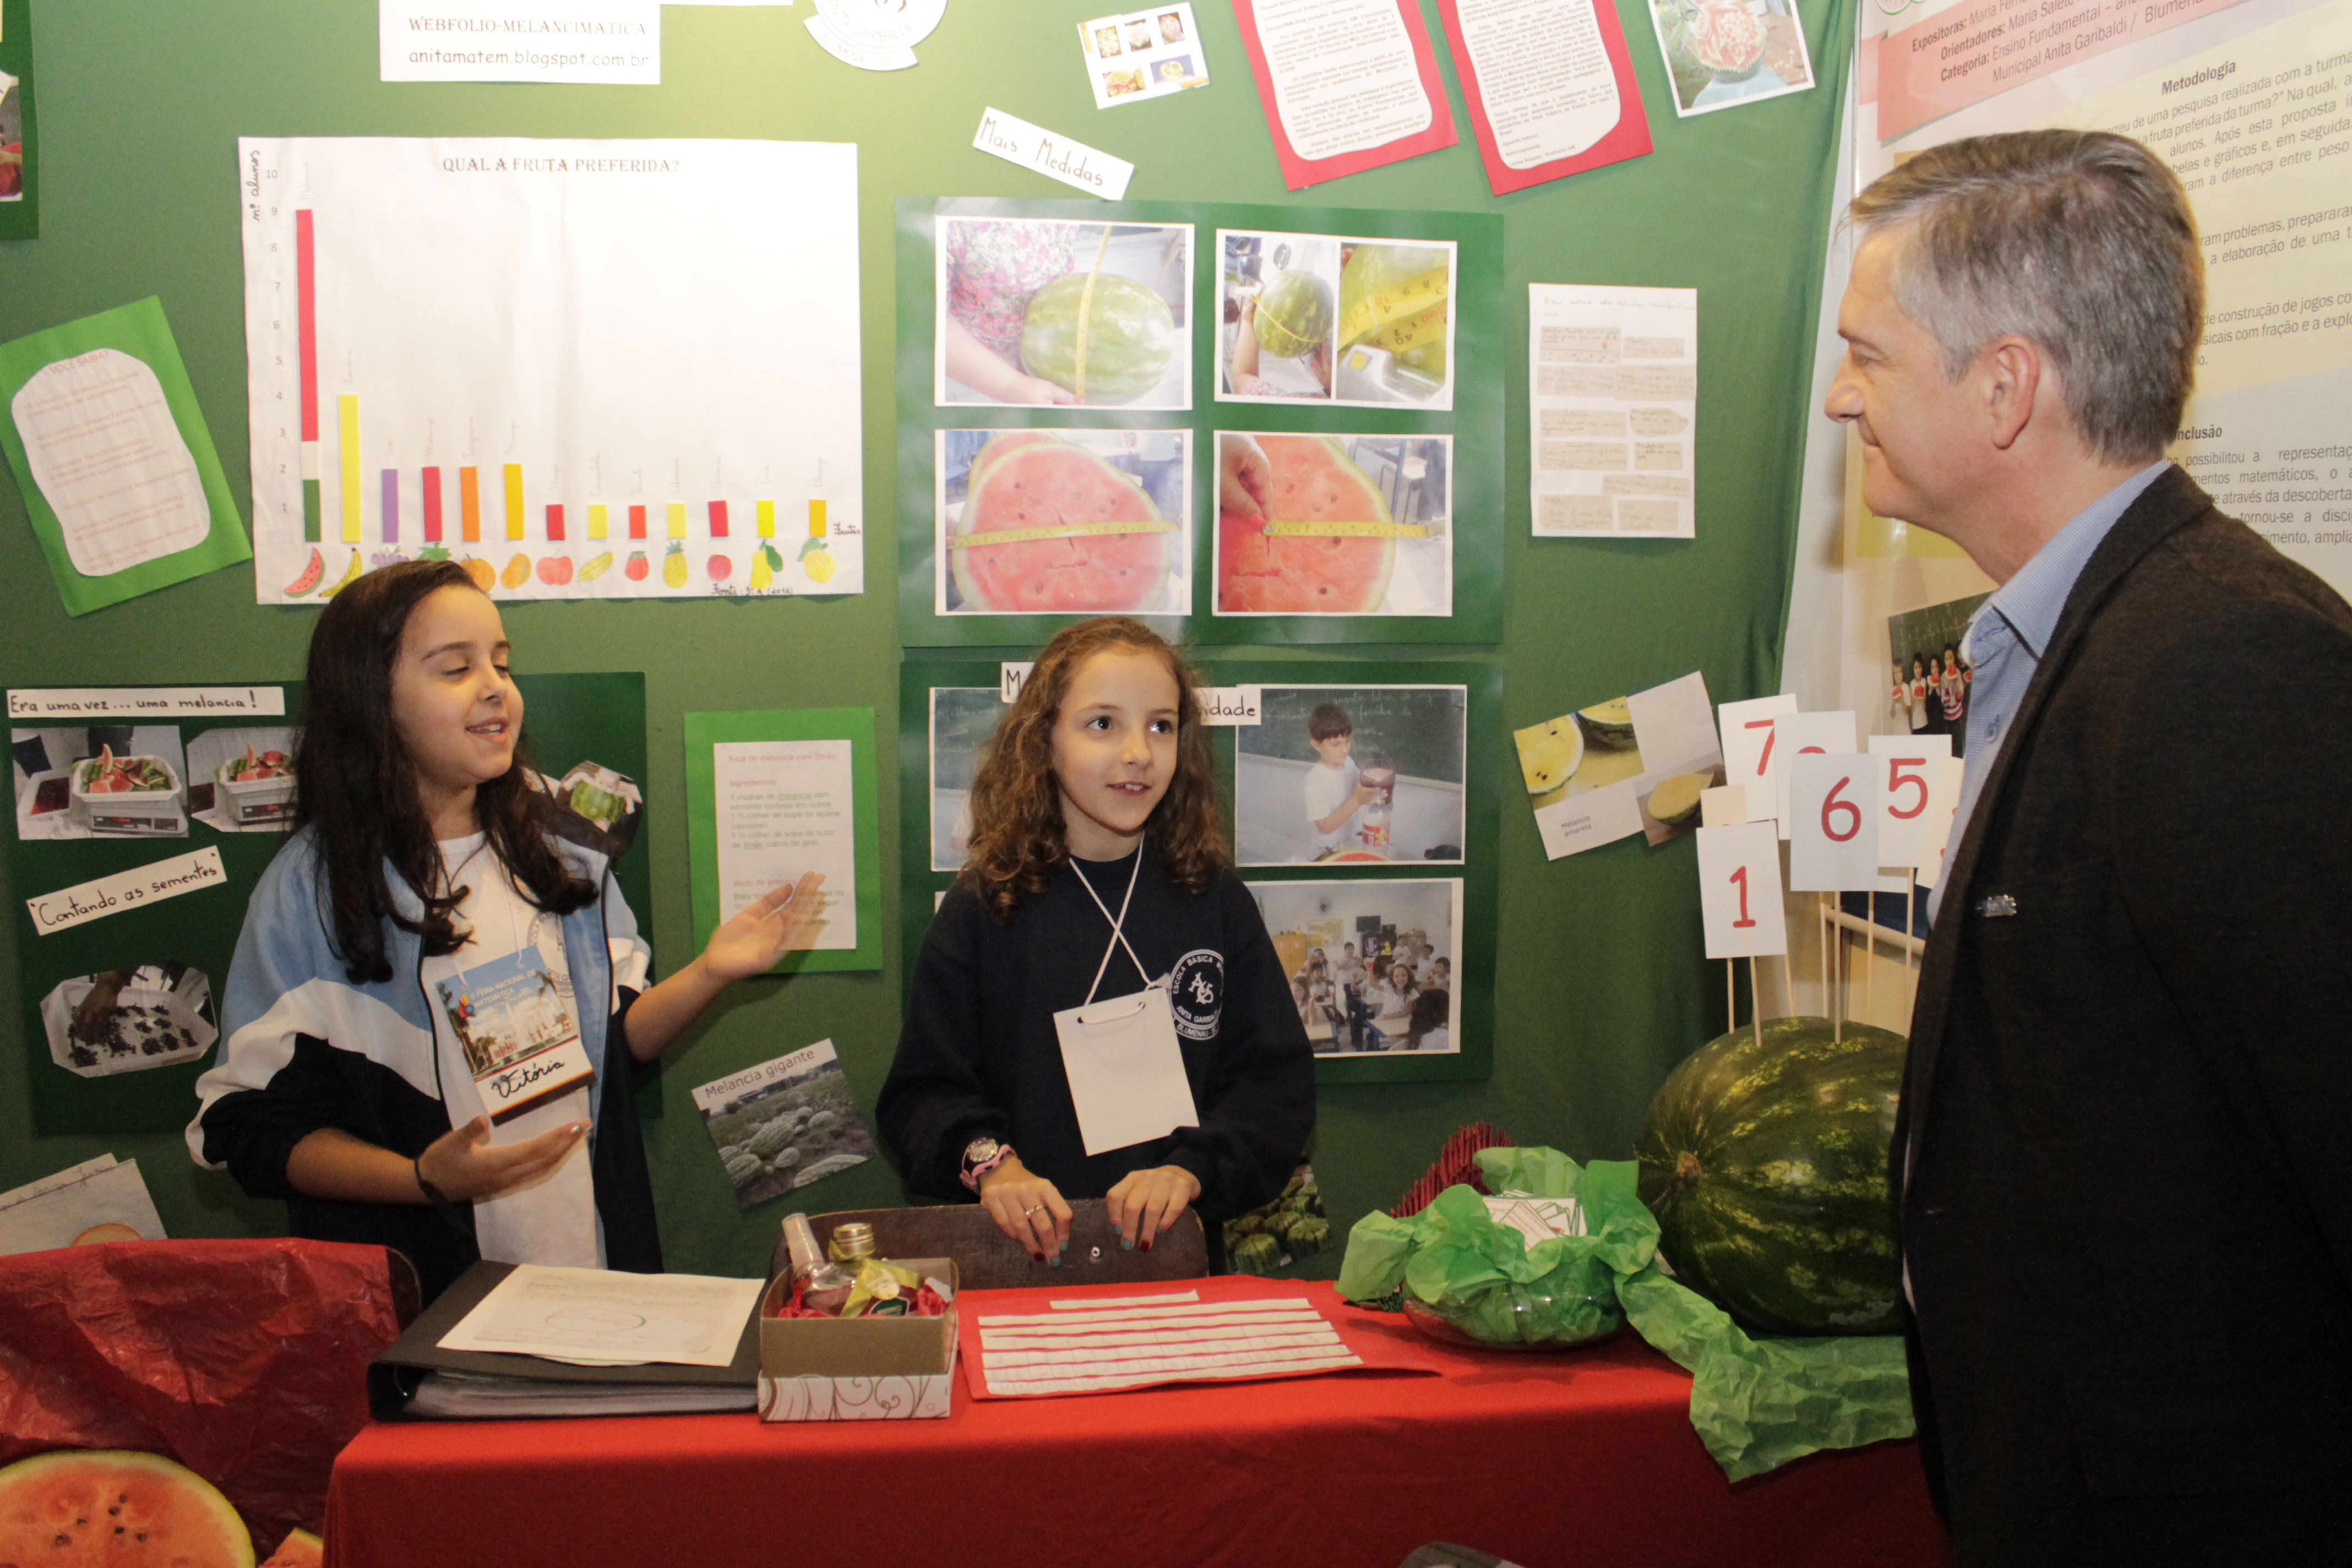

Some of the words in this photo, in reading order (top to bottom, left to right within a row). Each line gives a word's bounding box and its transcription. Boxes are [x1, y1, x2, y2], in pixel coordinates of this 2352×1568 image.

[1912, 18, 1967, 52] Expositoras:
[1969, 4, 1996, 26] Maria
[1941, 23, 2006, 61] Orientadores:
[2009, 9, 2037, 31] Maria
[1941, 53, 1990, 82] Categoria:
[1992, 37, 2026, 61] Ensino
[2029, 3, 2100, 46] Fundamental
[1993, 53, 2041, 84] Municipal
[2044, 41, 2072, 63] Anita
[2075, 16, 2127, 50] Garibaldi
[409, 49, 649, 69] anitamatem.blogspot.com.br
[2162, 61, 2236, 96] Metodologia
[2133, 117, 2144, 129] de
[2148, 110, 2169, 124] uma
[2173, 94, 2218, 119] pesquisa
[2222, 77, 2271, 102] realizada
[2275, 68, 2300, 85] com
[2305, 65, 2312, 76] a
[2150, 128, 2173, 143] fruta
[2175, 113, 2221, 136] preferida
[2223, 108, 2236, 121] da
[2287, 88, 2304, 102] Na
[2307, 77, 2337, 99] qual,
[2170, 138, 2207, 156] alunos.
[2214, 126, 2241, 145] Após
[2248, 118, 2272, 134] esta
[2282, 101, 2336, 128] proposta
[980, 116, 1018, 153] Mais
[1035, 138, 1103, 187] Medidas
[2204, 156, 2210, 167] e
[2214, 144, 2257, 167] gráficos
[2261, 140, 2272, 152] e,
[2277, 133, 2295, 147] em
[246, 150, 260, 197] alunos
[266, 170, 278, 179] 10
[443, 157, 490, 172] QUAL
[496, 158, 508, 172] A
[513, 157, 569, 172] FRUTA
[575, 159, 679, 173] PREFERIDA?
[2209, 175, 2216, 186] a
[2222, 160, 2273, 182] diferença
[2280, 150, 2312, 167] entre
[2318, 141, 2350, 161] peso
[271, 207, 277, 215] 9
[2224, 220, 2285, 244] problemas,
[270, 243, 277, 252] 8
[2210, 254, 2217, 265] a
[2223, 239, 2284, 263] elaboração
[2290, 235, 2306, 249] de
[2312, 230, 2339, 244] uma
[275, 282, 281, 291] 7
[2218, 302, 2279, 323] construção
[2283, 300, 2297, 313] de
[2299, 295, 2333, 314] jogos
[273, 320, 280, 330] 6
[2235, 327, 2258, 341] com
[2262, 320, 2299, 337] fração
[2302, 320, 2309, 331] e
[2312, 319, 2320, 330] a
[50, 357, 75, 375] VOCÊ
[77, 349, 110, 368] SABIA?
[276, 356, 282, 364] 5
[280, 428, 286, 437] 3
[2175, 424, 2222, 440] nclusão
[280, 465, 286, 473] 2
[2186, 452, 2245, 468] possibilitou
[2253, 451, 2260, 461] a
[2240, 467, 2318, 483] matemáticos,
[2330, 469, 2338, 479] o
[2222, 489, 2262, 504] através
[2265, 489, 2279, 503] da
[2240, 511, 2294, 524] tornou-se
[2304, 511, 2311, 522] a
[10, 695, 38, 712] Era
[47, 703, 80, 711] uma
[137, 699, 168, 709] uma
[1745, 719, 1774, 776] 7
[729, 779, 776, 788] Ingredientes
[1888, 758, 1928, 819] 5
[1821, 776, 1861, 842] 6
[1561, 816, 1591, 829] Melancia
[1564, 824, 1592, 837] amarela
[125, 888, 144, 901] as
[1729, 865, 1756, 928] 1
[1173, 966, 1186, 994] ESCOLA
[1177, 1005, 1191, 1020] ANITA
[1177, 1024, 1208, 1037] BLUMENAU
[491, 1061, 565, 1098] Vitória
[705, 1070, 762, 1098] Melancia
[766, 1049, 815, 1078] gigante
